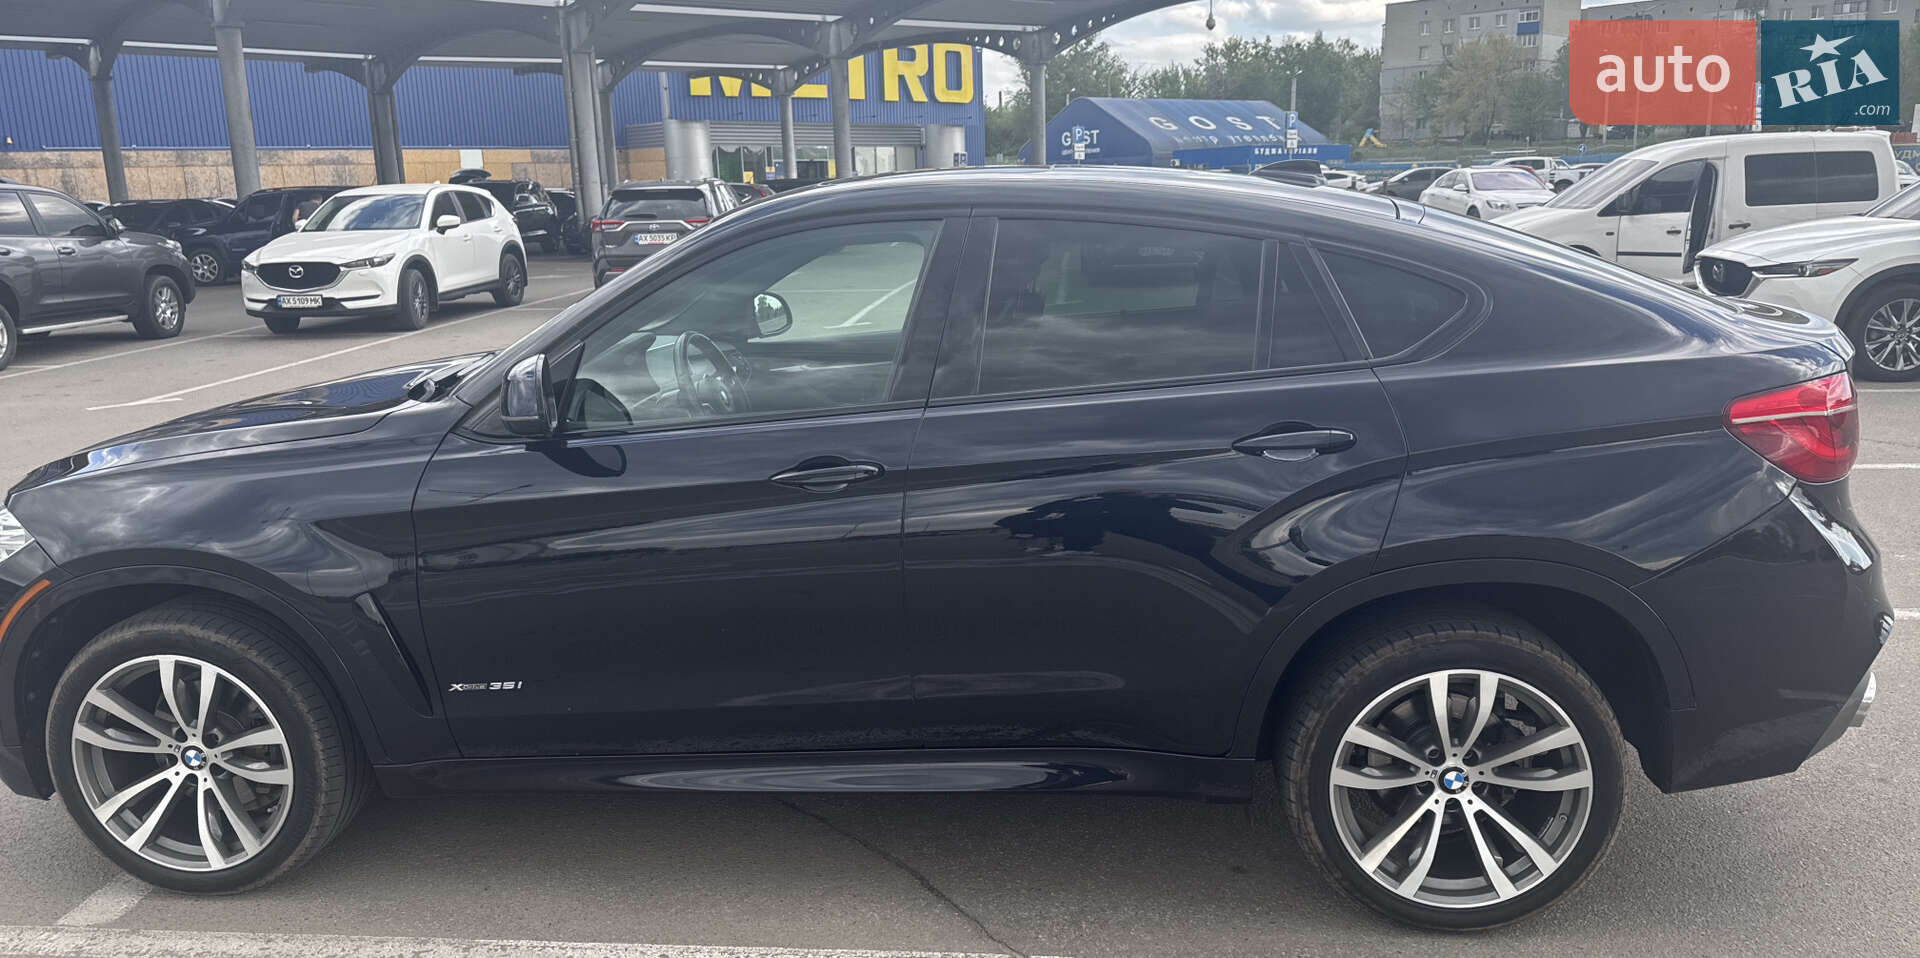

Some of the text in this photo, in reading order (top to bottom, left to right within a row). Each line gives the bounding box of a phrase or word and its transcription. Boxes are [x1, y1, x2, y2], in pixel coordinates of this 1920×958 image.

[1289, 113, 1297, 128] P
[1061, 129, 1100, 146] GST
[1075, 128, 1083, 141] P
